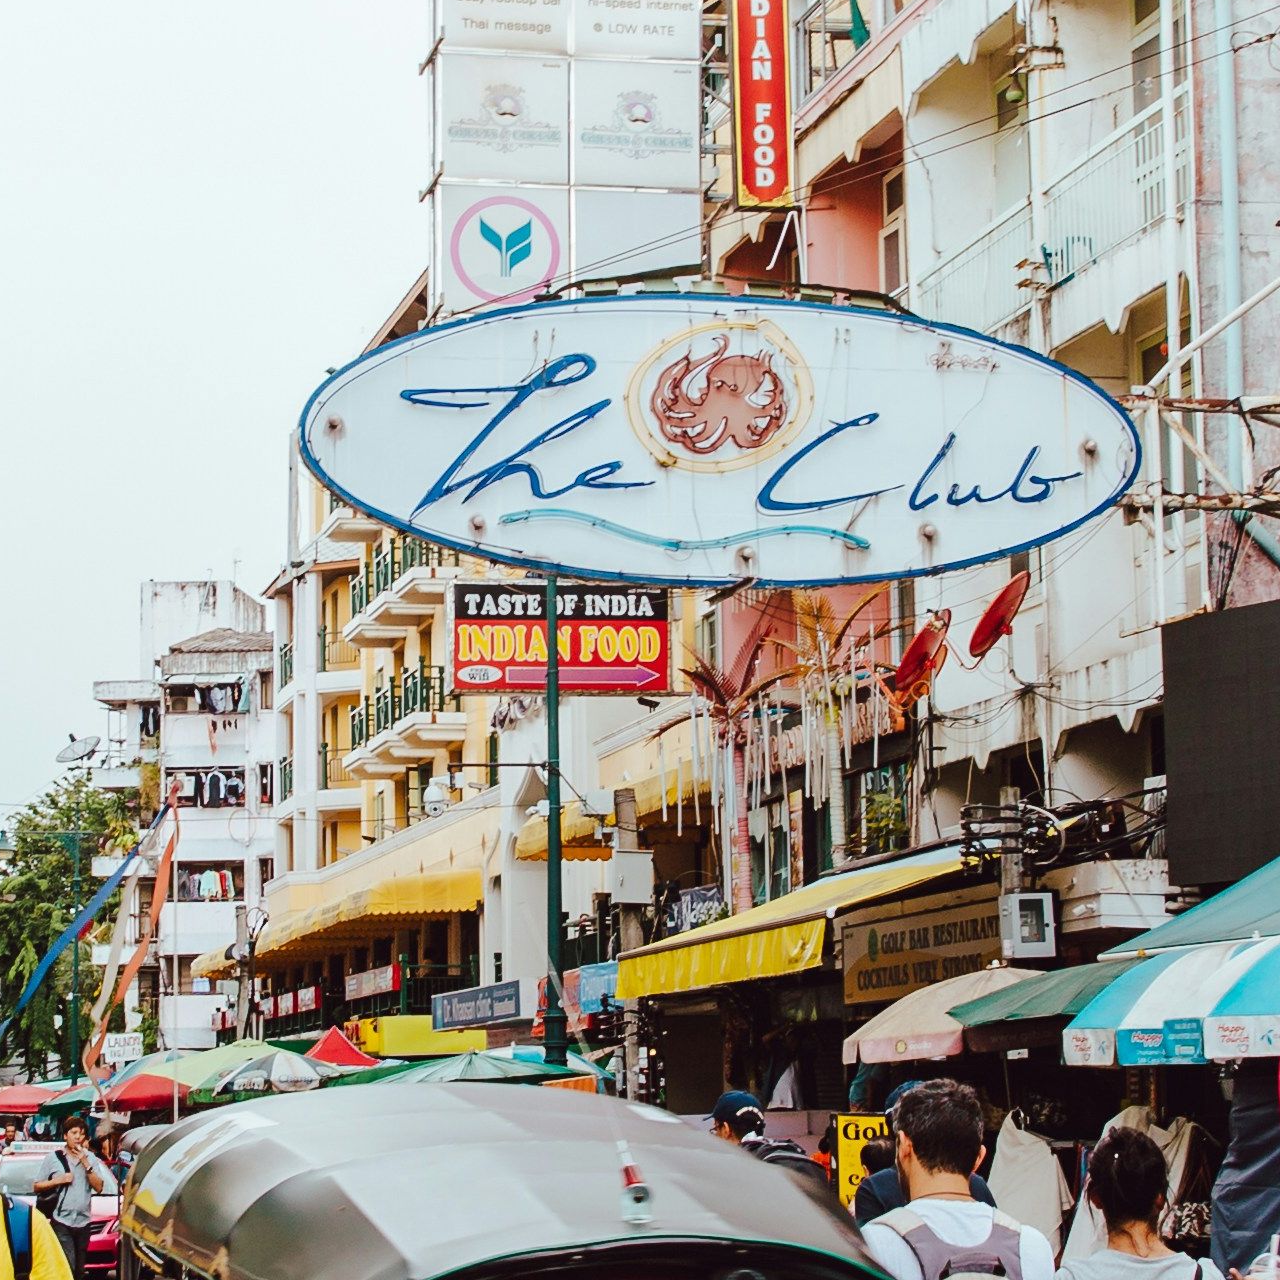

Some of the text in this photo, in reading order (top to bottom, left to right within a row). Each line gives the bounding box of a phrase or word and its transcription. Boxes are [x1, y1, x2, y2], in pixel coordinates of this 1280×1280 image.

[462, 17, 551, 34] Thai message
[608, 22, 639, 35] LOW
[643, 24, 675, 37] RATE
[753, 103, 775, 187] FOOD
[401, 353, 1085, 518] The Club
[464, 594, 542, 616] TASTE
[584, 595, 655, 617] INDIA
[457, 624, 661, 663] INDIAN FOOD
[881, 931, 906, 955] GOLF
[909, 926, 930, 950] BAR
[857, 963, 910, 992] COCKTAILS
